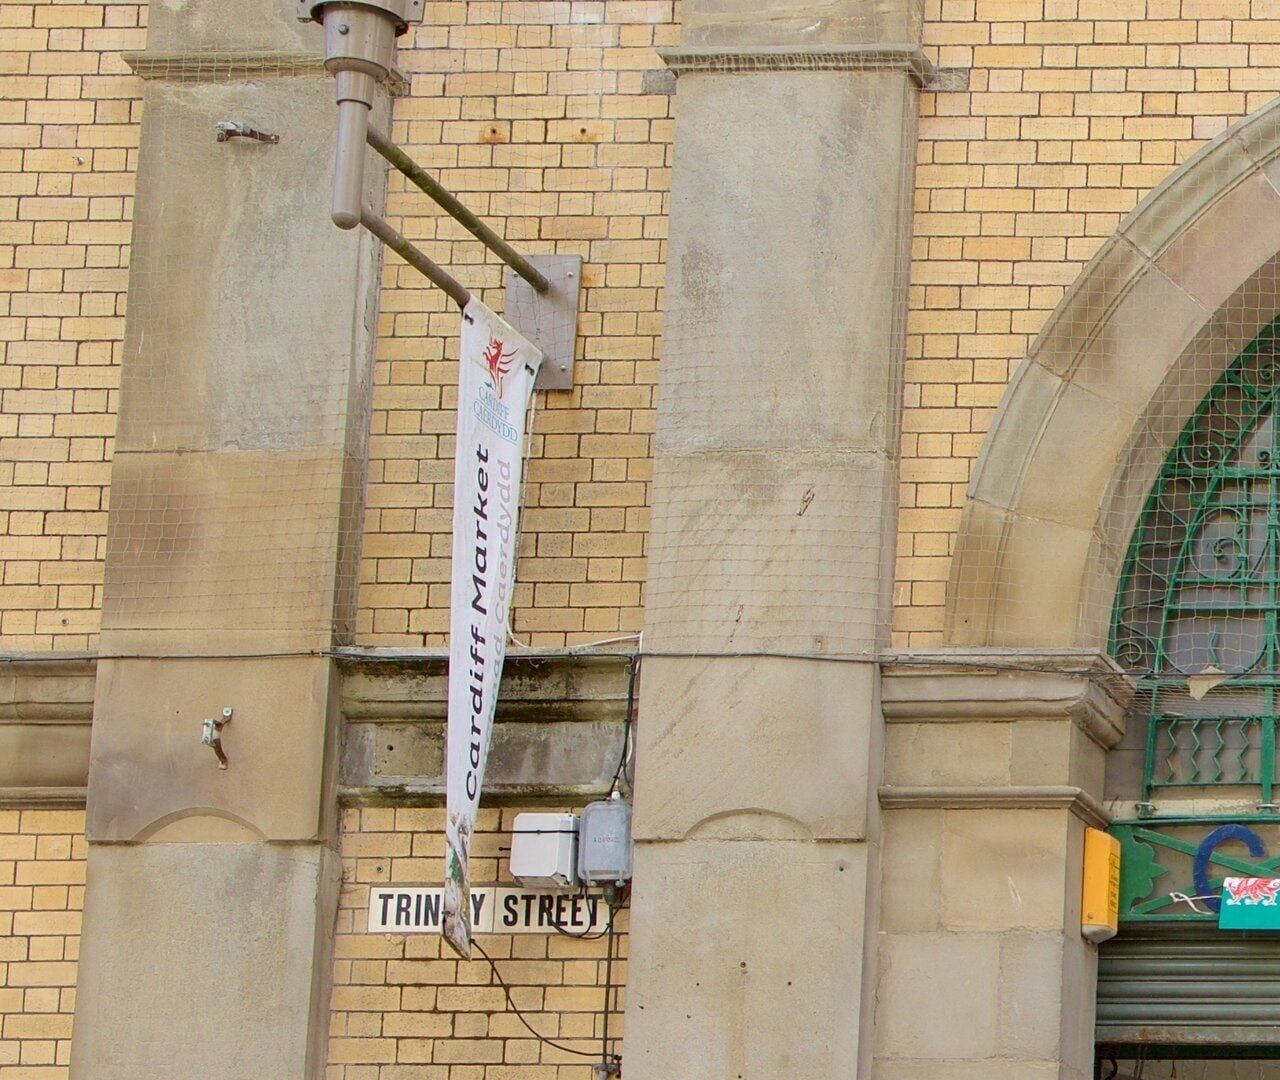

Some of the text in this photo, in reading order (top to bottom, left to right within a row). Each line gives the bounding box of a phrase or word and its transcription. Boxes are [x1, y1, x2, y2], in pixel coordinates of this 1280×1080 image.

[474, 401, 518, 442] CAERDYDD
[479, 386, 510, 421] CARDIFF
[495, 457, 513, 624] Caerdydd
[466, 443, 489, 801] Cardiff Market
[378, 893, 603, 927] TRINY STREET
